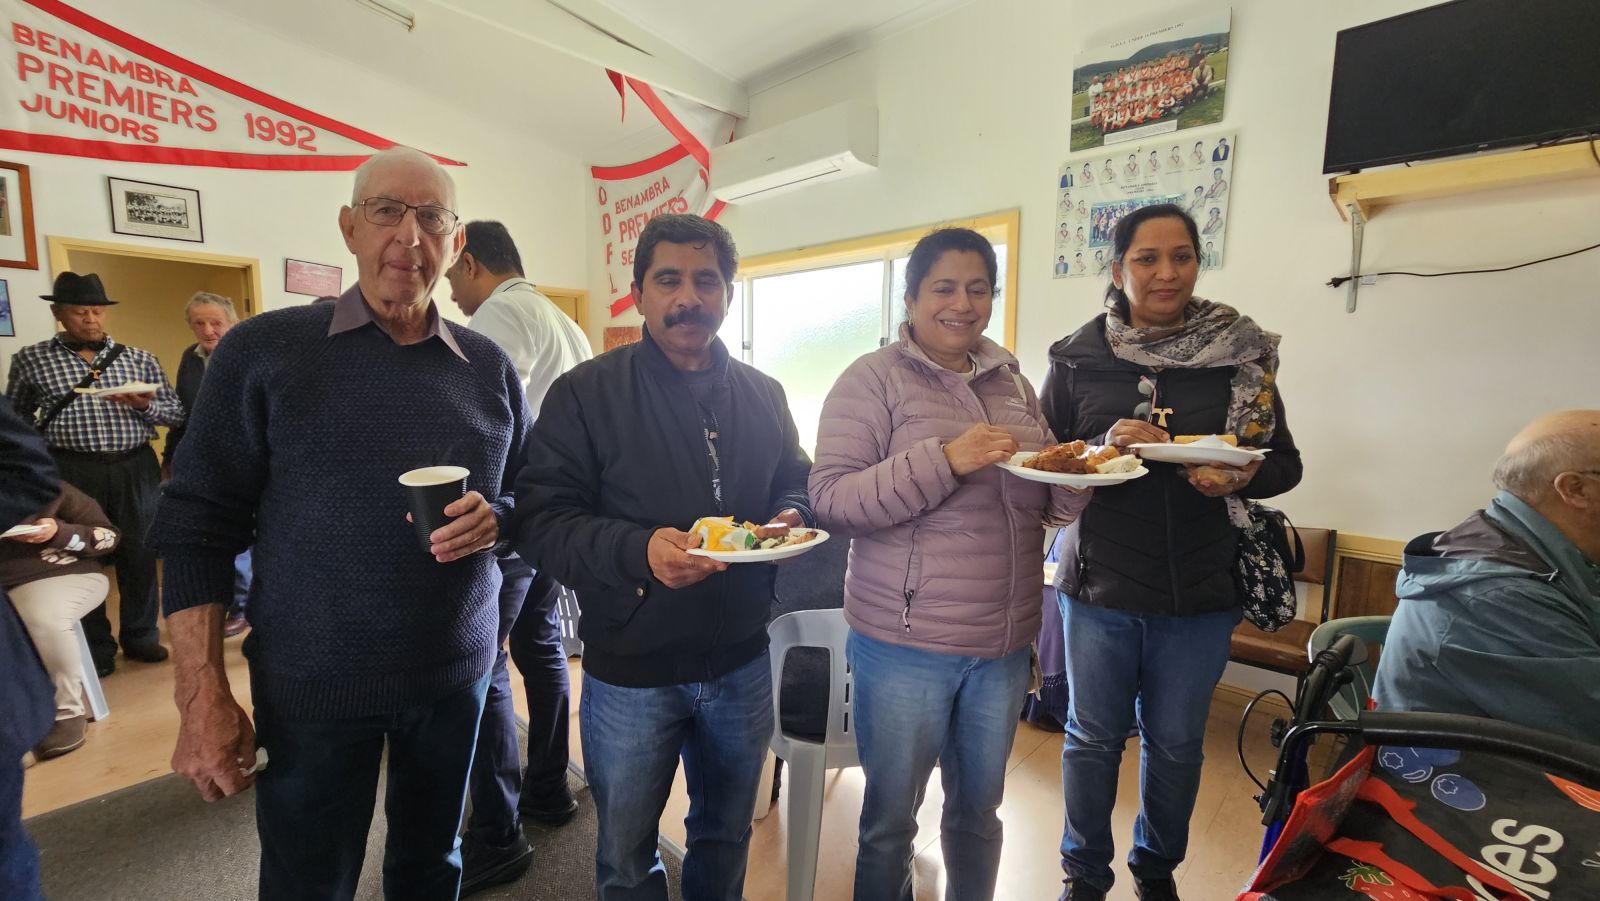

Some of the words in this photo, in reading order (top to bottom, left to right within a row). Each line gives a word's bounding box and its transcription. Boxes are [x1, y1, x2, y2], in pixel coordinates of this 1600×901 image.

[11, 21, 199, 98] BENAMBRA
[17, 51, 218, 133] PREMIERS
[244, 112, 318, 152] 1992
[19, 93, 160, 144] JUNIORS
[615, 176, 670, 214] BENAMBRA
